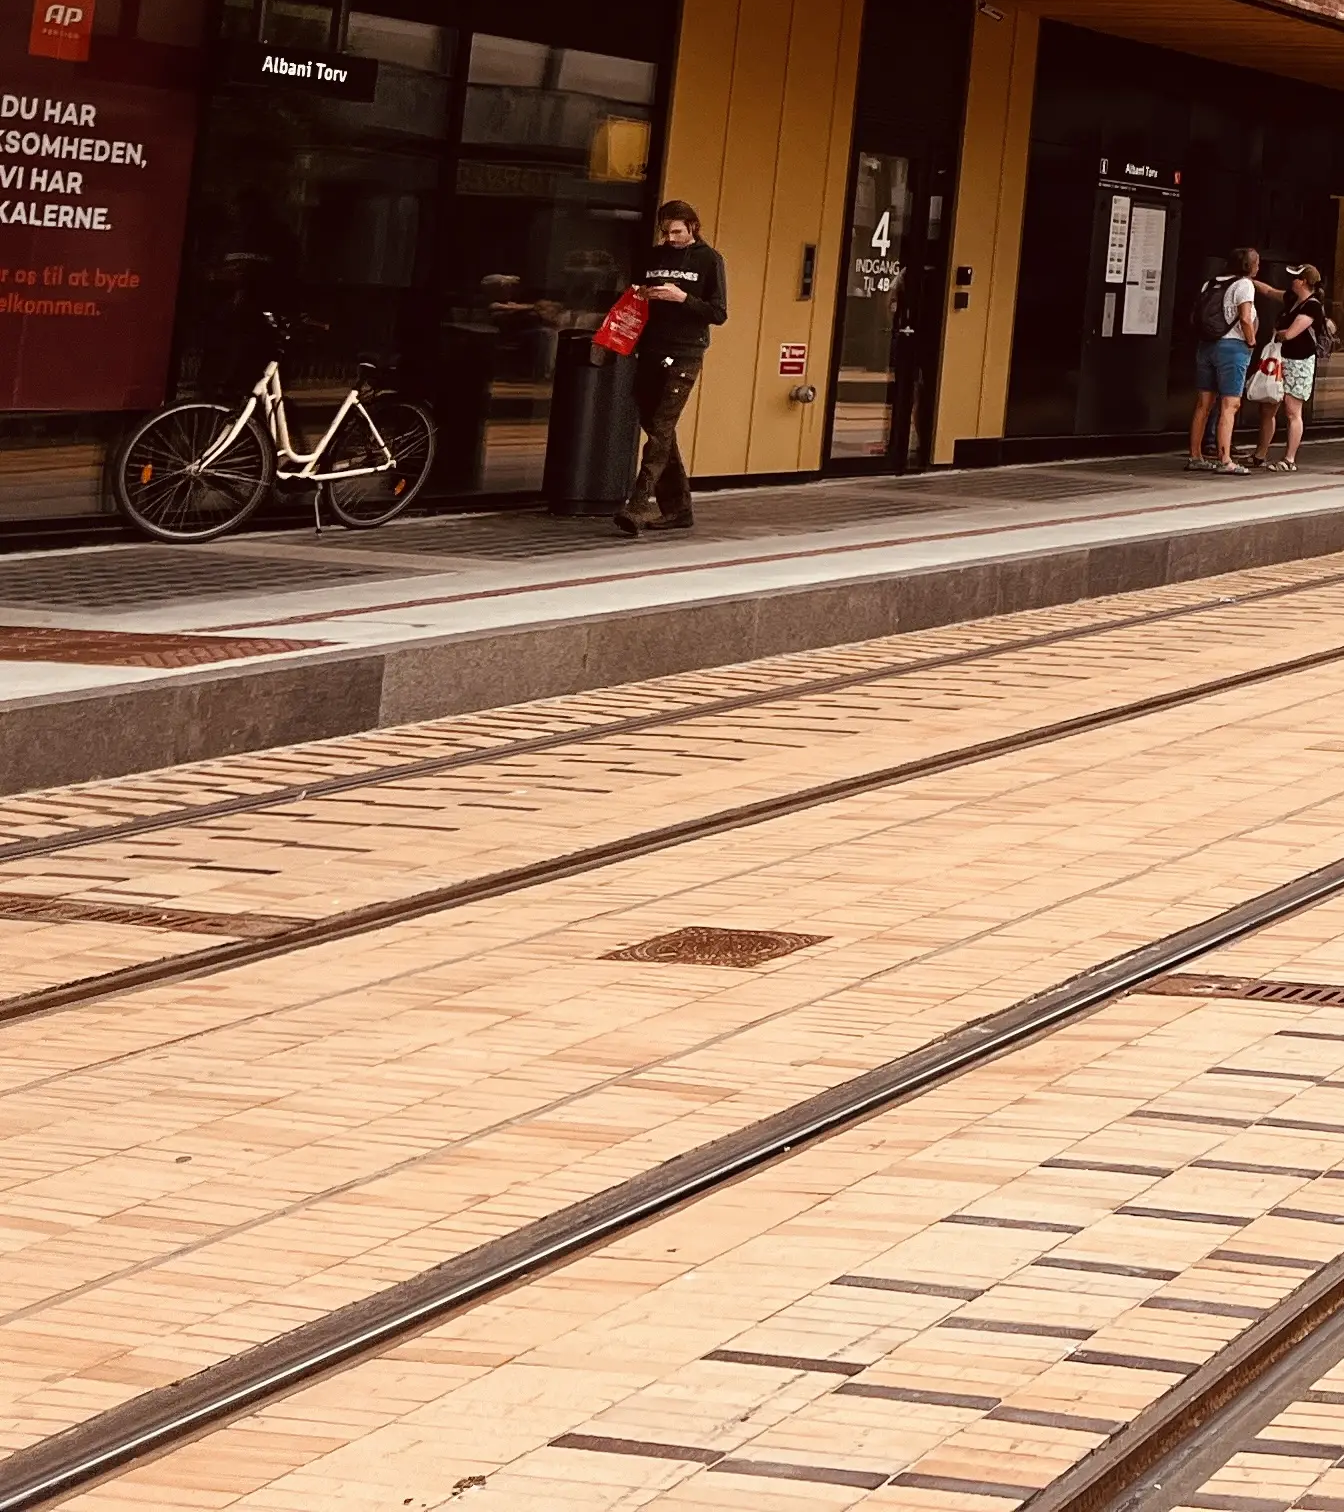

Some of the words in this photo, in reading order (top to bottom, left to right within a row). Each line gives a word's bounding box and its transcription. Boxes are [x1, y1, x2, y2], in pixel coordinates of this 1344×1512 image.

[45, 4, 83, 26] AP
[262, 56, 312, 78] Albani
[316, 63, 348, 83] Torv
[1, 94, 39, 120] DU
[43, 99, 97, 127] HAR
[0, 164, 24, 189] VI
[30, 167, 83, 194] HAR
[871, 211, 891, 257] 4
[15, 269, 37, 285] os
[43, 265, 64, 286] til
[68, 268, 89, 287] at
[94, 268, 140, 293] byde
[856, 258, 900, 275] INDGANG
